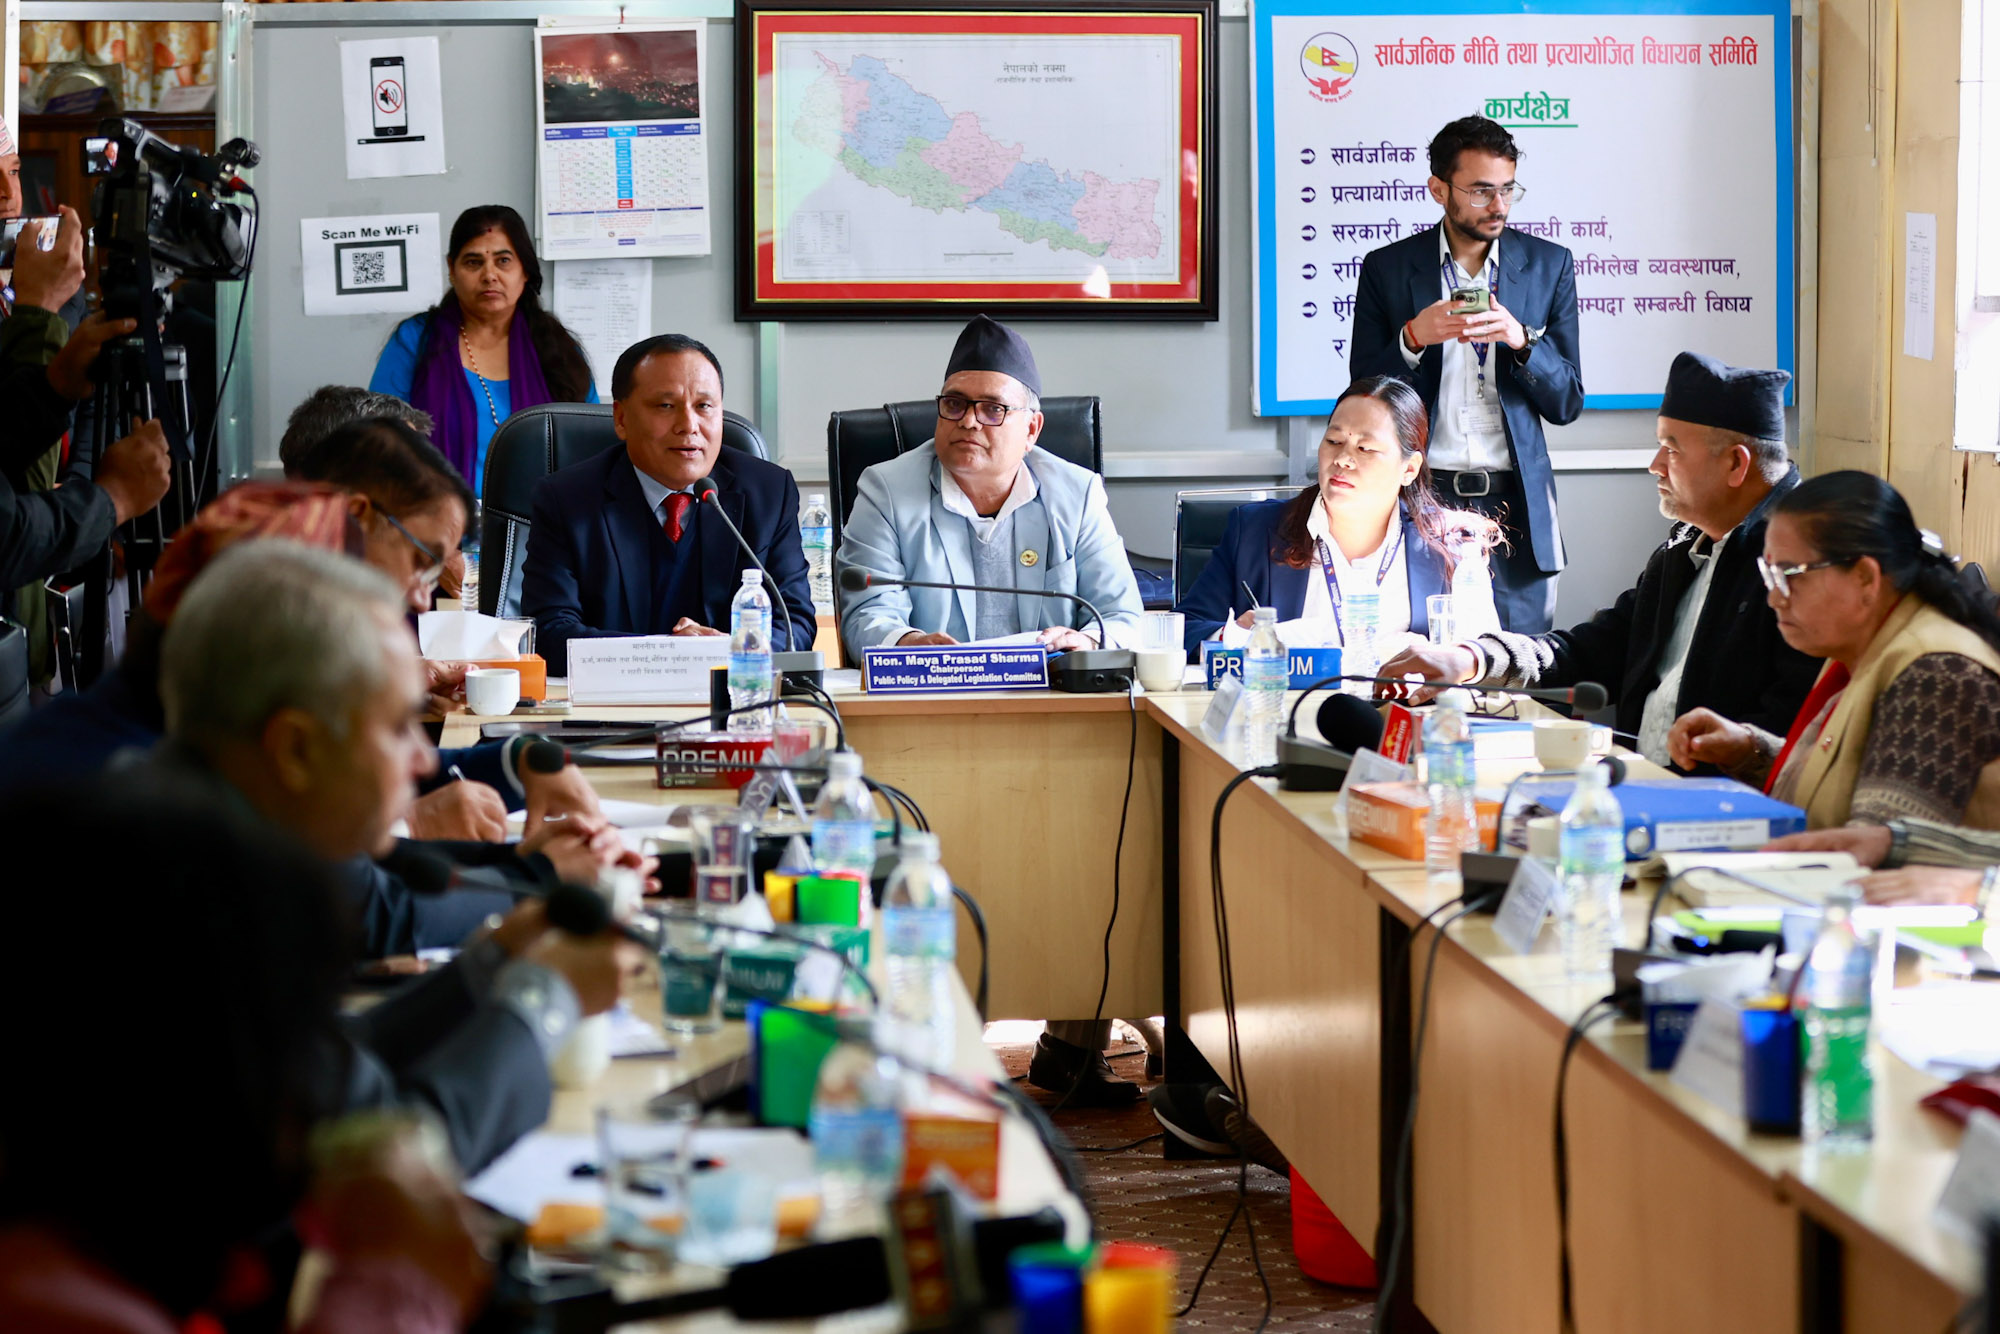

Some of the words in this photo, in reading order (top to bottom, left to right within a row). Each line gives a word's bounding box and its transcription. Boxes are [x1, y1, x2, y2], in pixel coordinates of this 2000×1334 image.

[1374, 36, 1456, 67] सार्वजनिक
[1463, 35, 1499, 65] नीति
[1506, 43, 1538, 65] तथा
[1545, 35, 1635, 67] प्रत्यायोजित
[1642, 36, 1702, 66] विधायन
[1709, 36, 1758, 67] समिति
[1003, 61, 1038, 73] नेपालको
[1485, 91, 1570, 121] कार्यक्षेत्र
[1330, 140, 1417, 166] सार्वजनिक
[1331, 178, 1428, 204] प्रत्यायोजित
[321, 229, 356, 240] Scan
[361, 227, 381, 238] Me
[385, 224, 419, 236] Wi-Fi
[1331, 217, 1401, 244] सरकारी
[1571, 216, 1613, 241] कार्य,
[1647, 258, 1741, 280] व्यवस्थापन,
[1633, 290, 1697, 316] सम्बन्धी
[1704, 289, 1753, 314] विषय
[1332, 339, 1346, 359] र
[872, 655, 902, 667] Hon.
[905, 654, 939, 668] Maya
[942, 653, 987, 666] Prasad
[990, 653, 1039, 664] Sharma
[930, 665, 985, 674] Chairperson
[1212, 656, 1313, 676] PRUM
[873, 675, 896, 685] Public
[897, 674, 919, 686] Policy
[920, 674, 926, 684] &
[927, 673, 963, 685] Delegated
[964, 672, 1003, 685] Legislation
[1003, 672, 1042, 683] Committee
